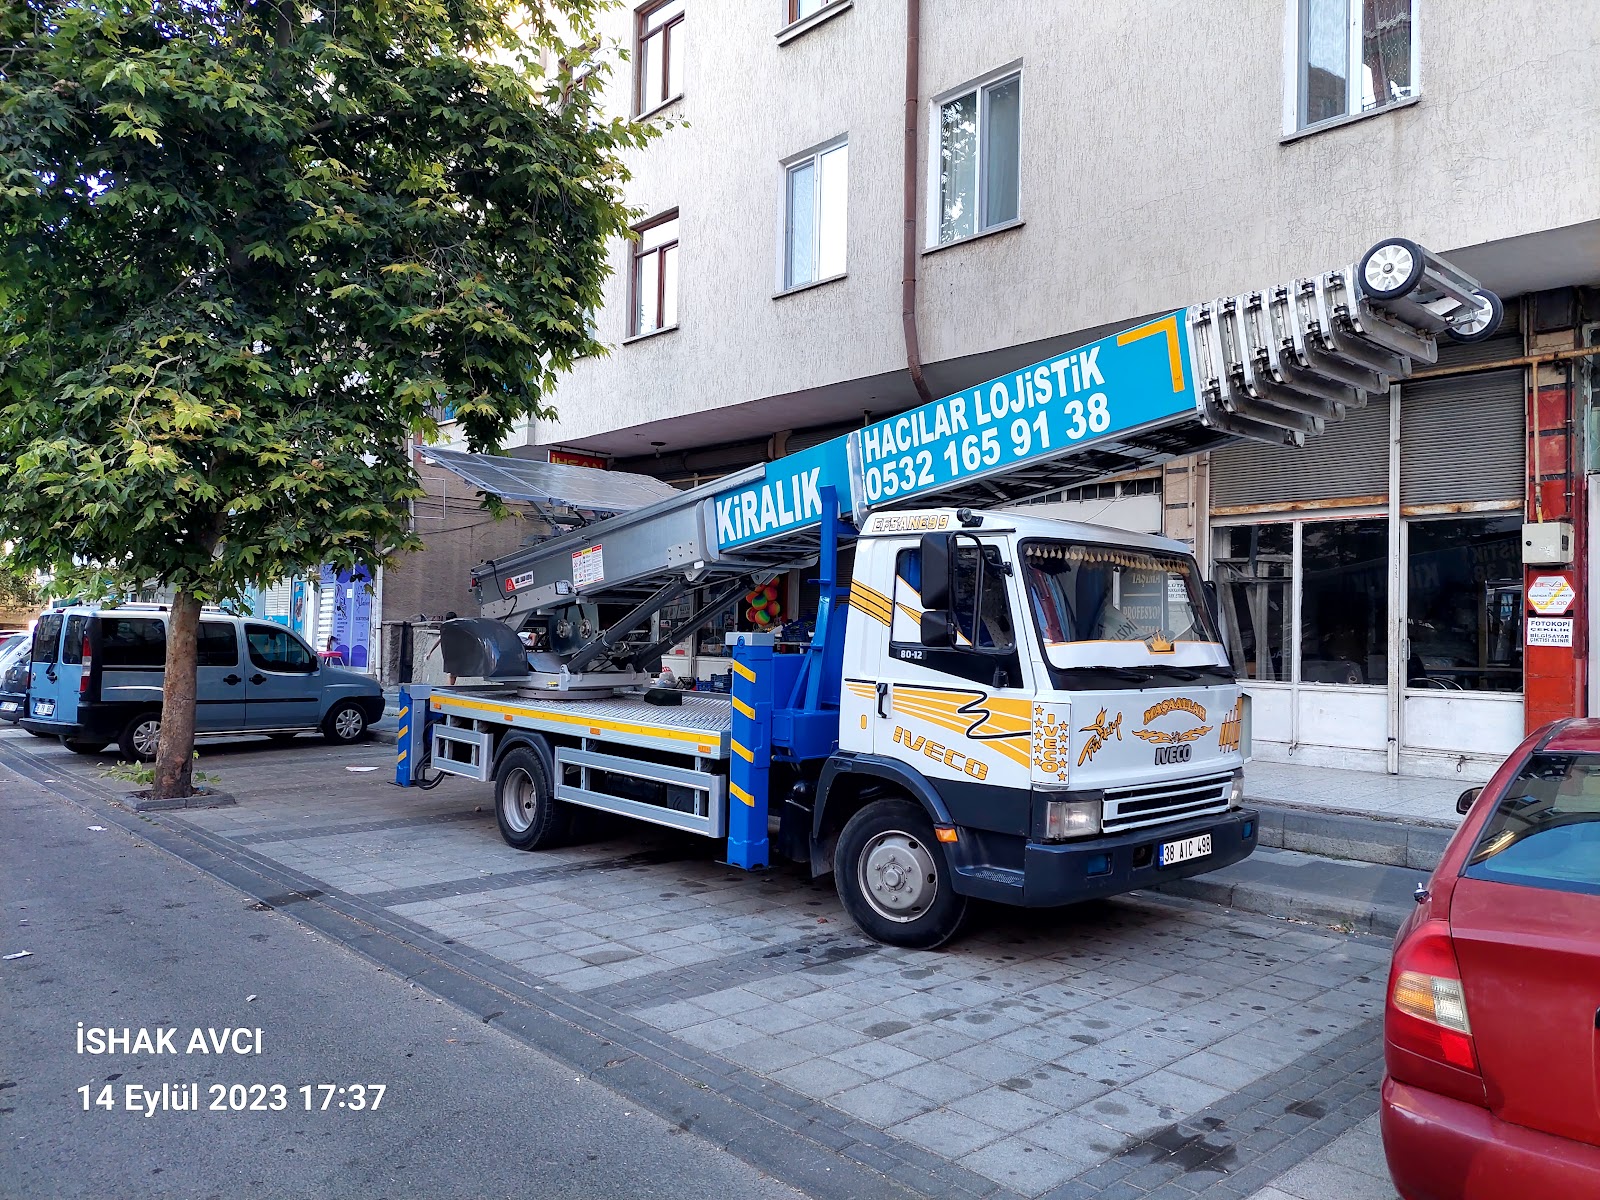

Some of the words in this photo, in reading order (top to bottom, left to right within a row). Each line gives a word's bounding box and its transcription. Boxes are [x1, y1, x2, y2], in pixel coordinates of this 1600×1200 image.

[864, 396, 968, 464] HACILAR
[866, 451, 936, 501] 0532
[943, 428, 1001, 476] 165
[1011, 410, 1051, 457] 91
[1064, 392, 1111, 440] 38
[892, 726, 989, 781] IVECO
[1041, 714, 1059, 773] IVECO
[1154, 744, 1192, 766] IVECO
[1165, 845, 1174, 862] 38
[1179, 840, 1193, 859] AIC
